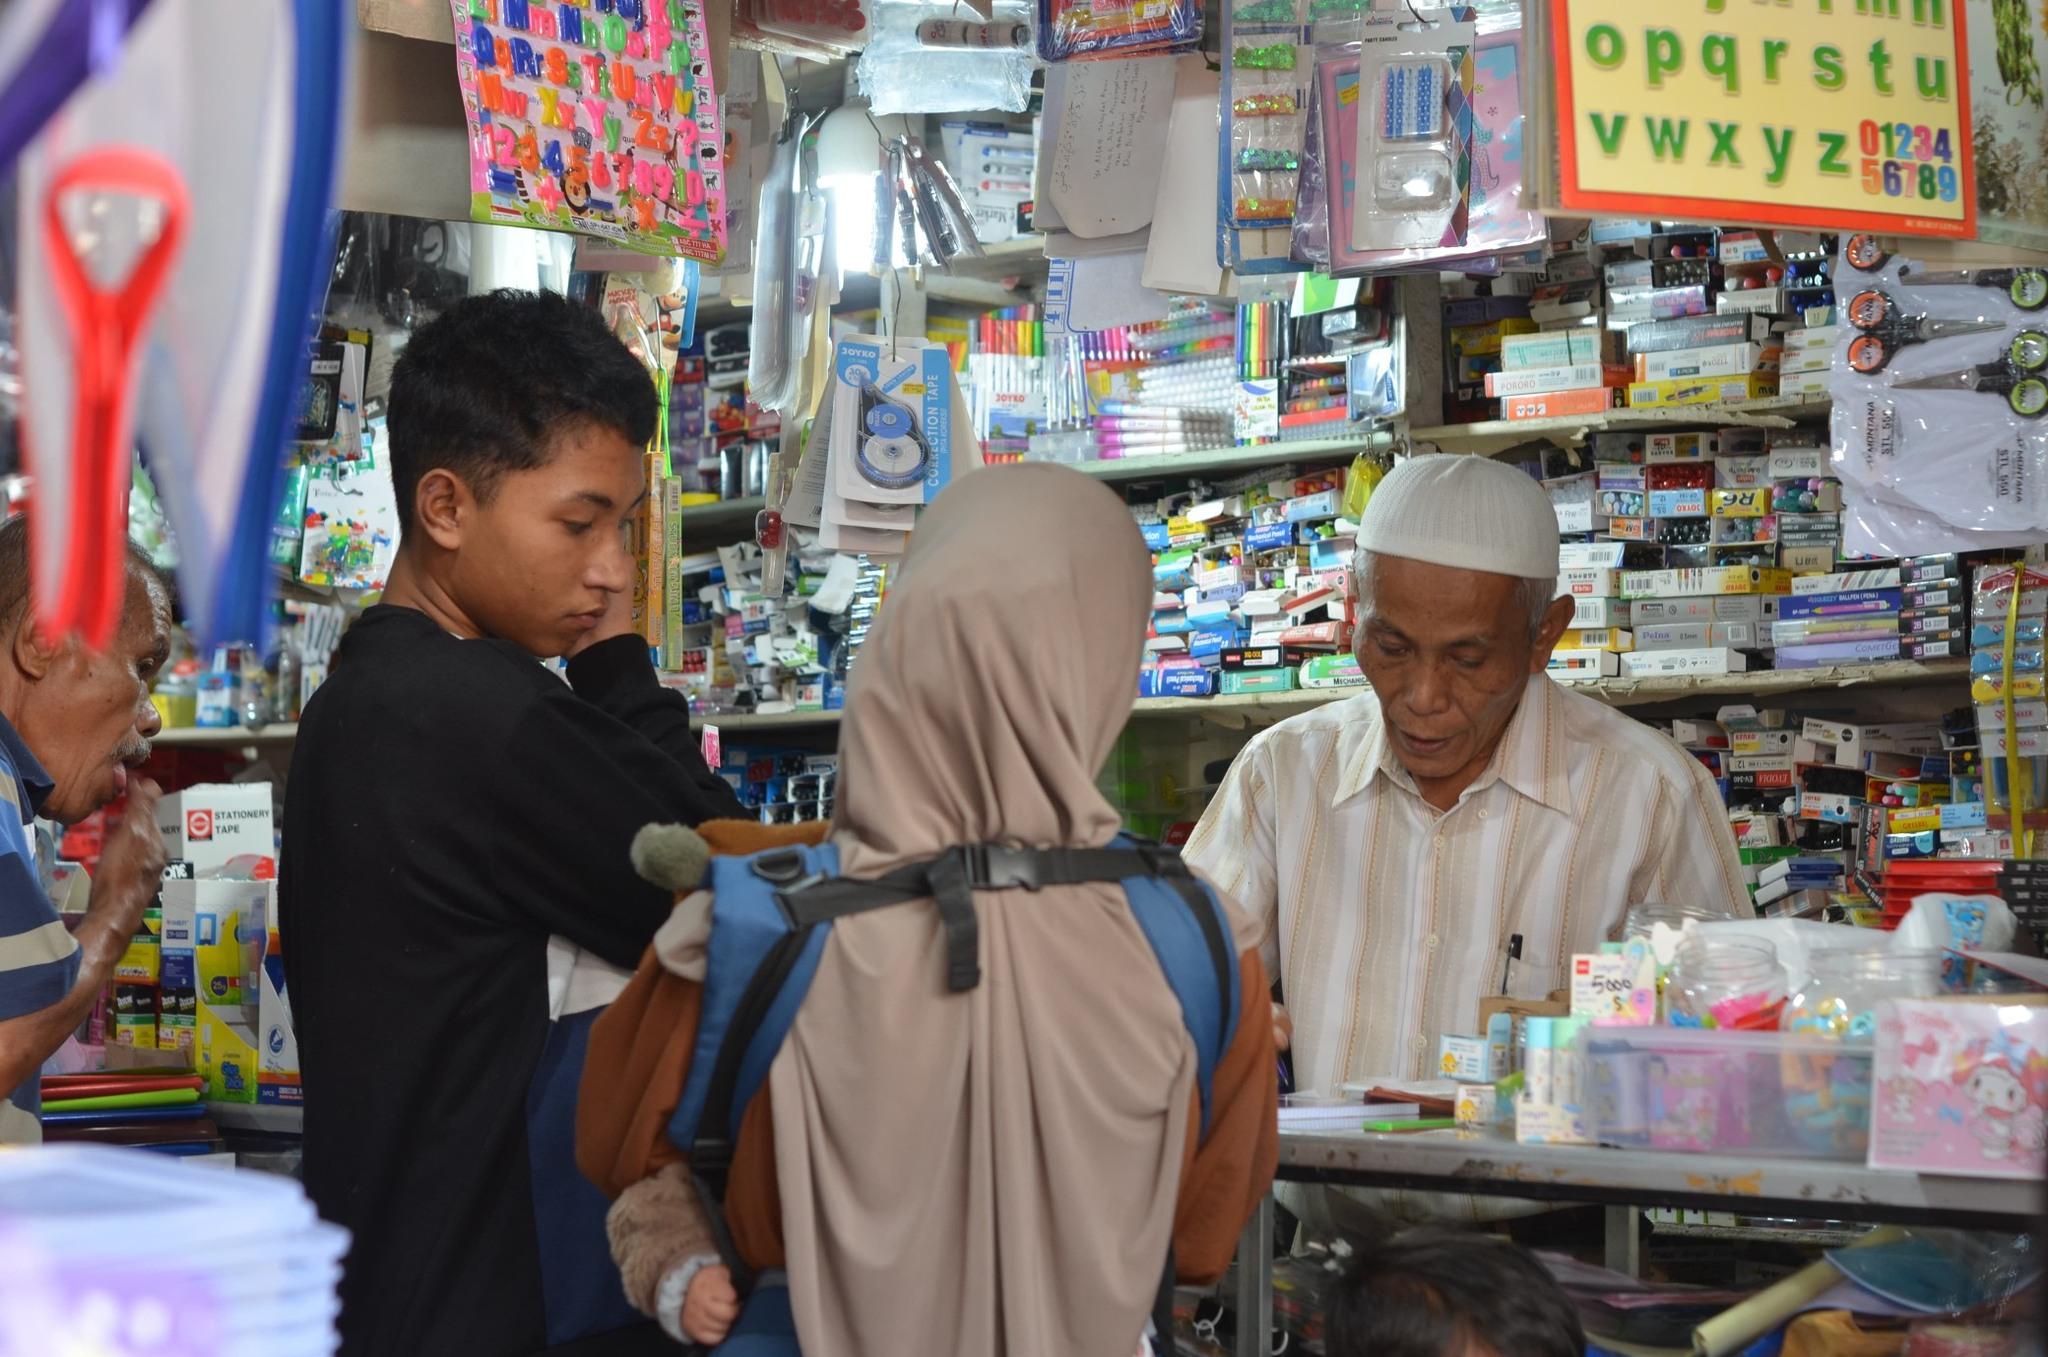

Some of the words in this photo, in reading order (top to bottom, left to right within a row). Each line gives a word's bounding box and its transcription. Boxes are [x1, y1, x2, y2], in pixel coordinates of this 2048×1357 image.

[1645, 28, 1683, 88] p
[1701, 33, 1739, 93] q
[1762, 38, 1788, 82] r
[1812, 44, 1845, 90] s
[1869, 38, 1893, 95] t
[1915, 57, 1947, 100] u
[1588, 112, 1628, 155] v
[1645, 116, 1689, 162] w
[1707, 121, 1743, 167] x
[1762, 125, 1796, 186] y
[1818, 132, 1851, 175] z
[841, 347, 876, 359] JOYKO
[927, 375, 938, 401] TAPE
[1866, 401, 1875, 452] MONTANA
[926, 407, 939, 487] CORRECTION
[2015, 450, 2023, 503] MONTANA
[1722, 492, 1756, 506] R6
[214, 810, 270, 820] STATIONERY
[215, 825, 240, 833] TAPE
